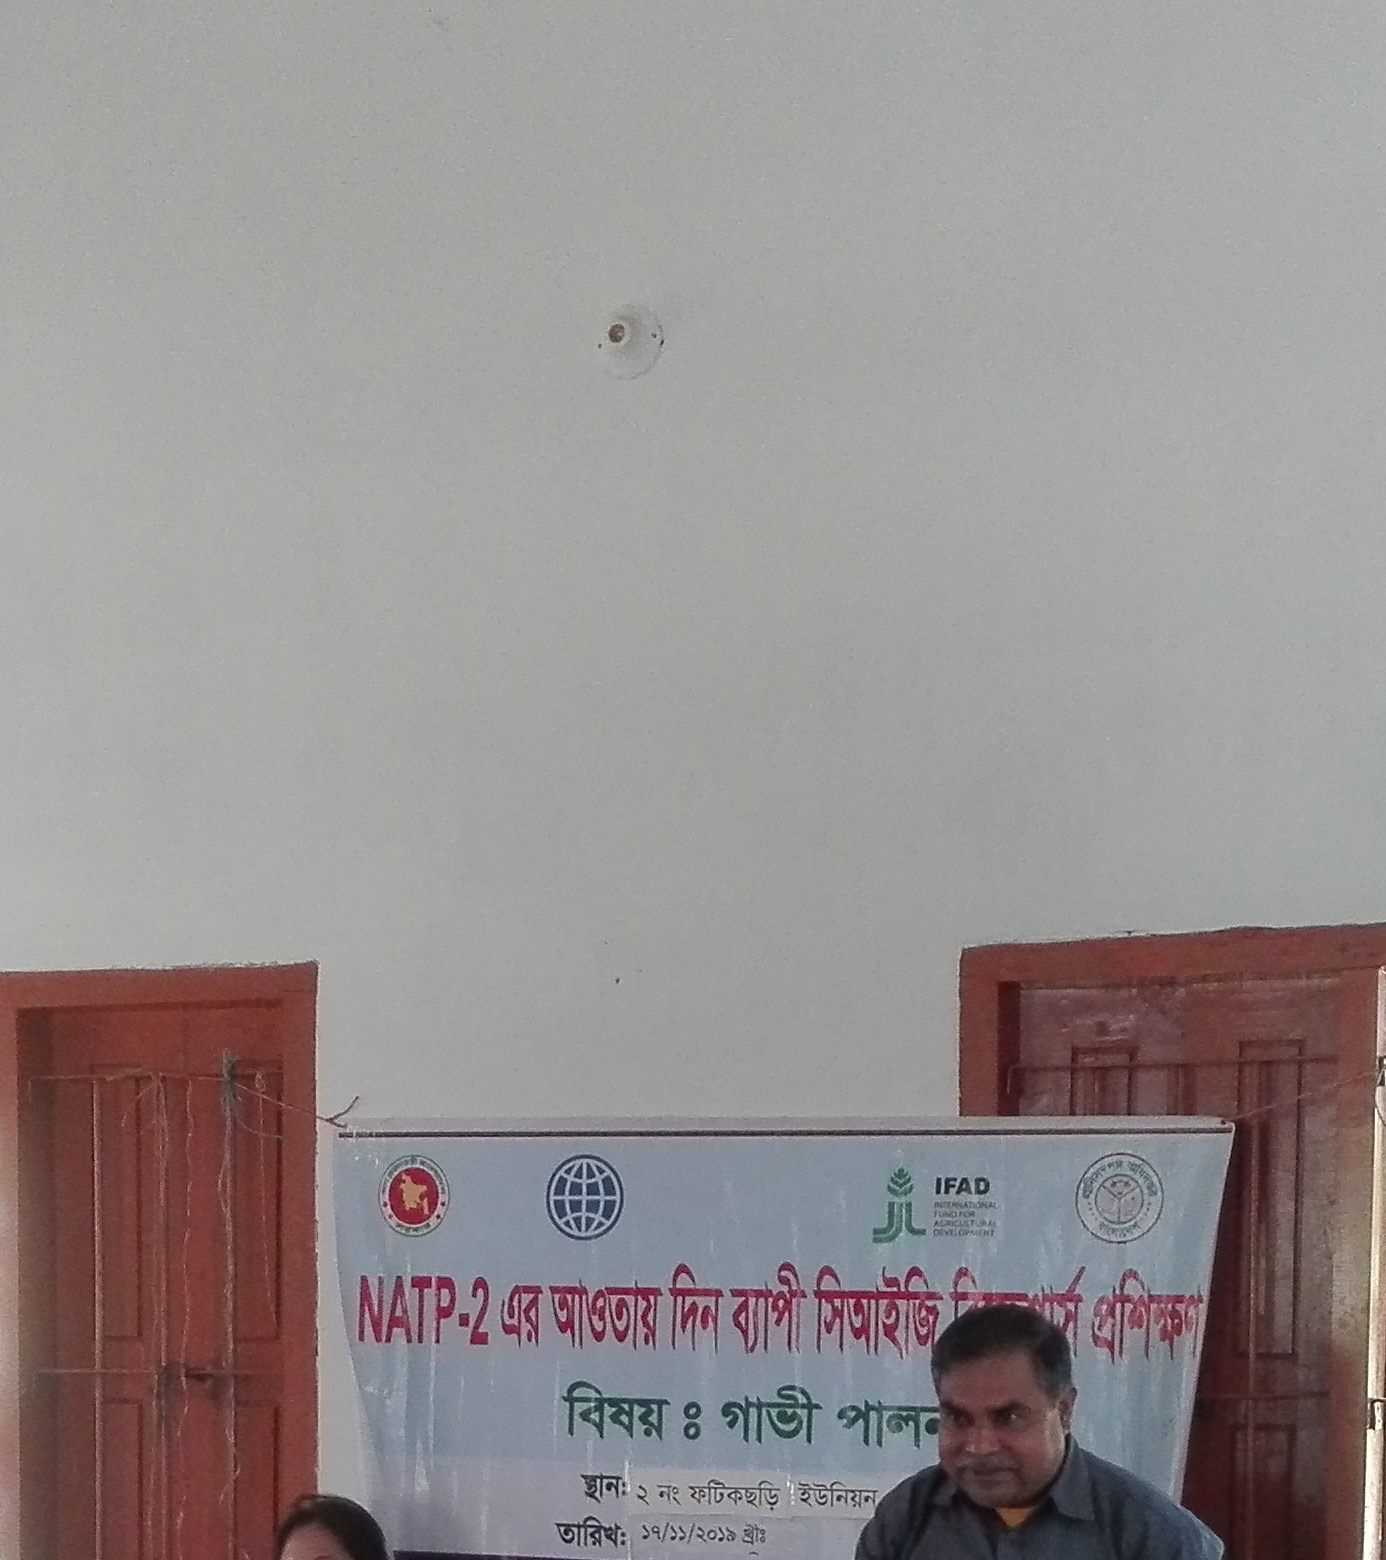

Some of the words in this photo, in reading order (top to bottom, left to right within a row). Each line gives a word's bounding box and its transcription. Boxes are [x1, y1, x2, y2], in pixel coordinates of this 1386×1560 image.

[935, 1177, 990, 1195] IFAD
[934, 1201, 997, 1209] INTERNATIONAL
[933, 1220, 996, 1228] AGRICULTURAL
[933, 1229, 995, 1237] DEVELOPMENT
[358, 1275, 489, 1346] NATP-2
[501, 1284, 543, 1348] এর
[549, 1279, 663, 1350] আওতায়
[669, 1263, 724, 1352] দিন
[730, 1262, 807, 1353] ব্যাপী
[814, 1265, 943, 1358] সিআইজি
[562, 1380, 671, 1440] বিষয়
[721, 1384, 822, 1444] গাভী
[636, 1485, 650, 1506] ২
[657, 1485, 681, 1505] নং
[688, 1479, 780, 1511] ফটিকছড়ি
[798, 1481, 878, 1508] ইউনিয়ন
[642, 1522, 736, 1543] ১৭/১১/২০১৯
